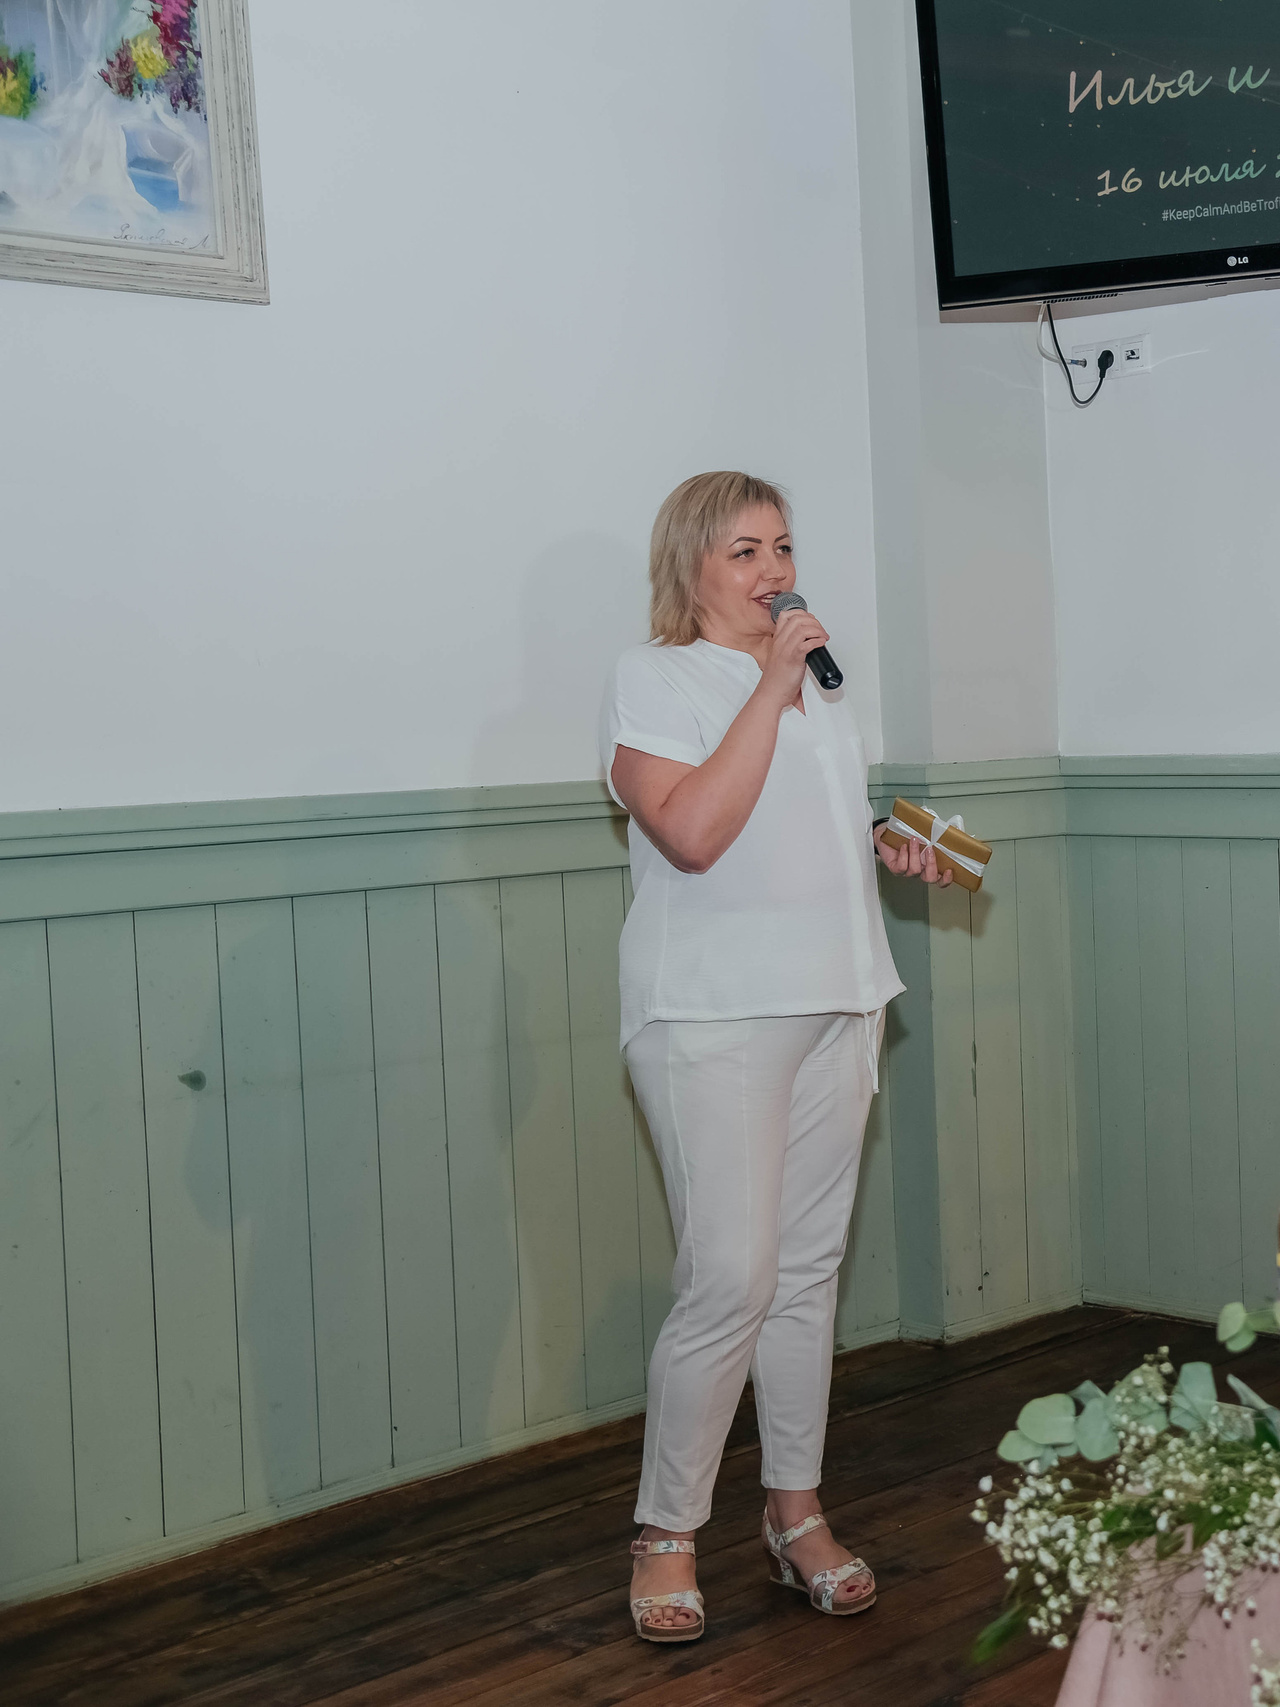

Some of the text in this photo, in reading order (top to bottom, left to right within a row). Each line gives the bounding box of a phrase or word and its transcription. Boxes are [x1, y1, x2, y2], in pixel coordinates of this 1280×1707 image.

[1068, 69, 1213, 113] Илья
[1227, 64, 1270, 93] и
[1097, 167, 1143, 197] 16
[1158, 158, 1267, 189] июля
